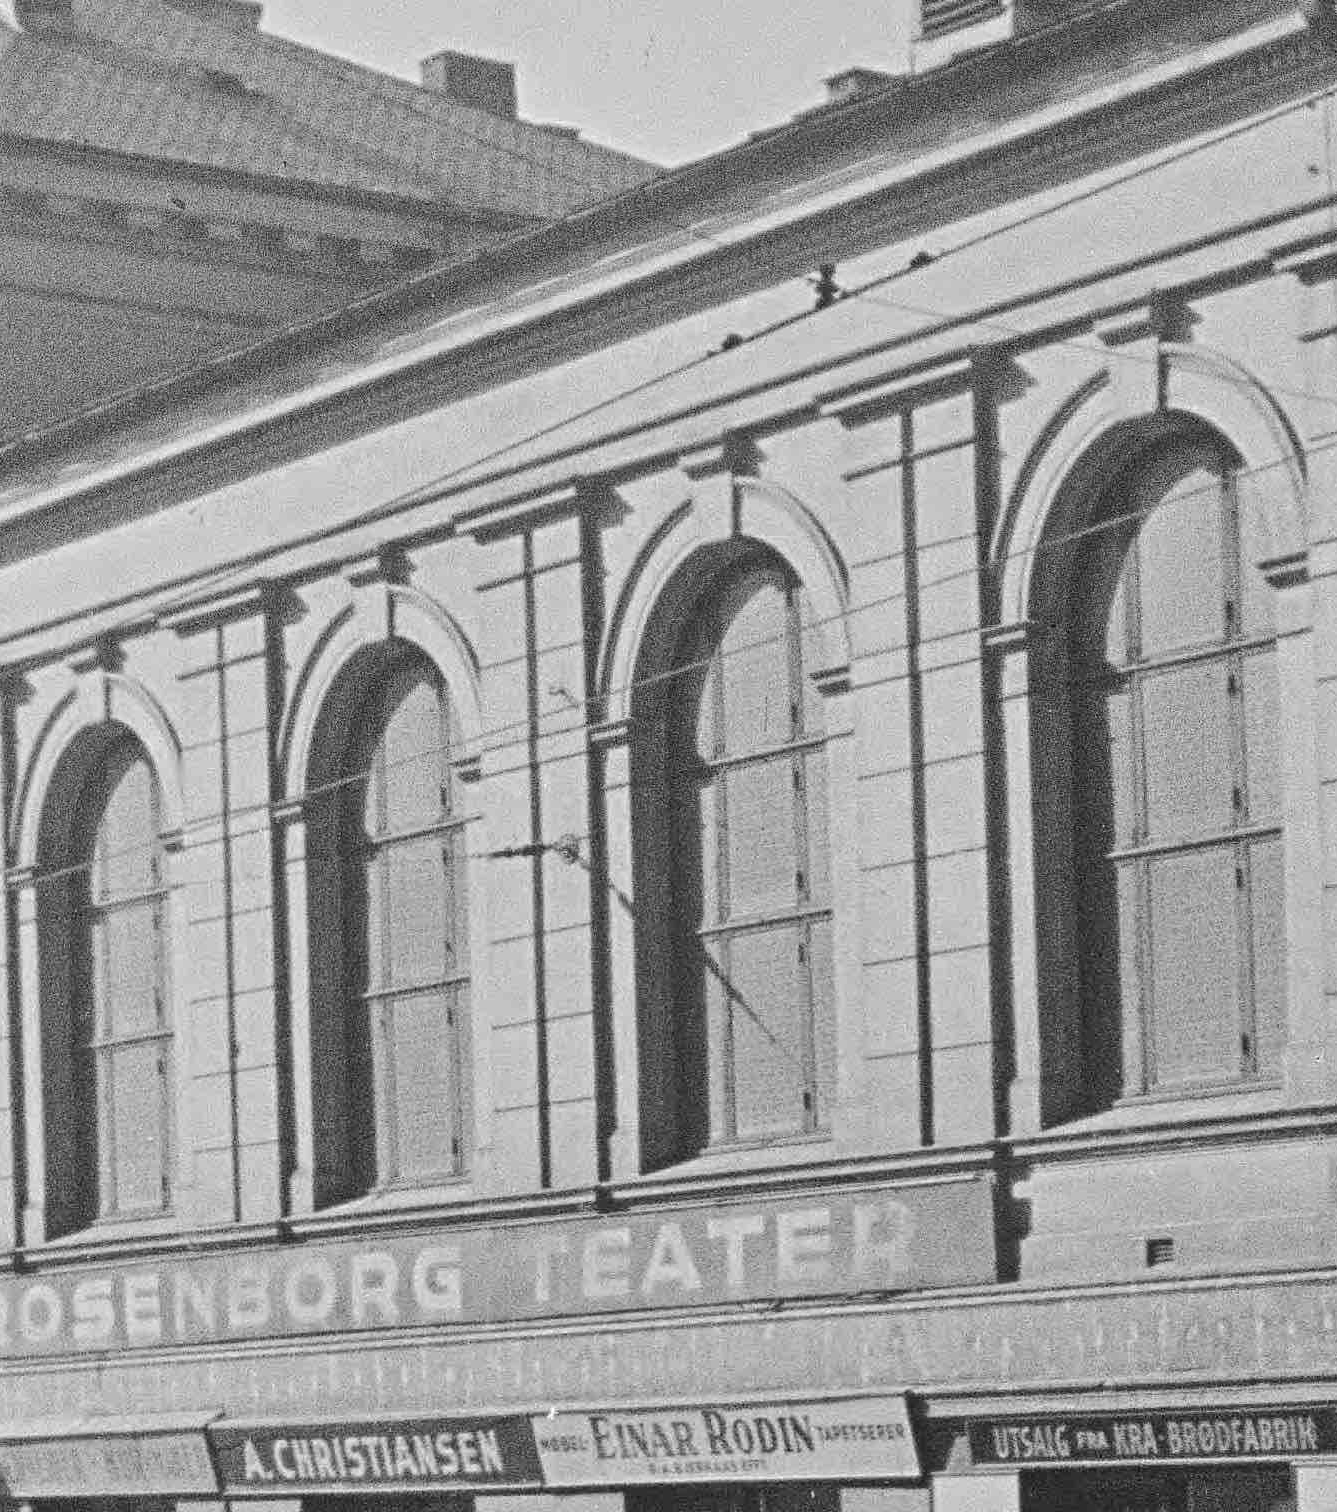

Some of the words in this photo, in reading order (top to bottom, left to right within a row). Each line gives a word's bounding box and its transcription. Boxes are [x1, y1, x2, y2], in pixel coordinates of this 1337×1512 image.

[527, 1201, 914, 1303] TEATER
[589, 1415, 701, 1460] EINAR
[701, 1408, 815, 1456] RODIN
[992, 1423, 1071, 1459] UTSALG
[1076, 1430, 1109, 1450] FRA
